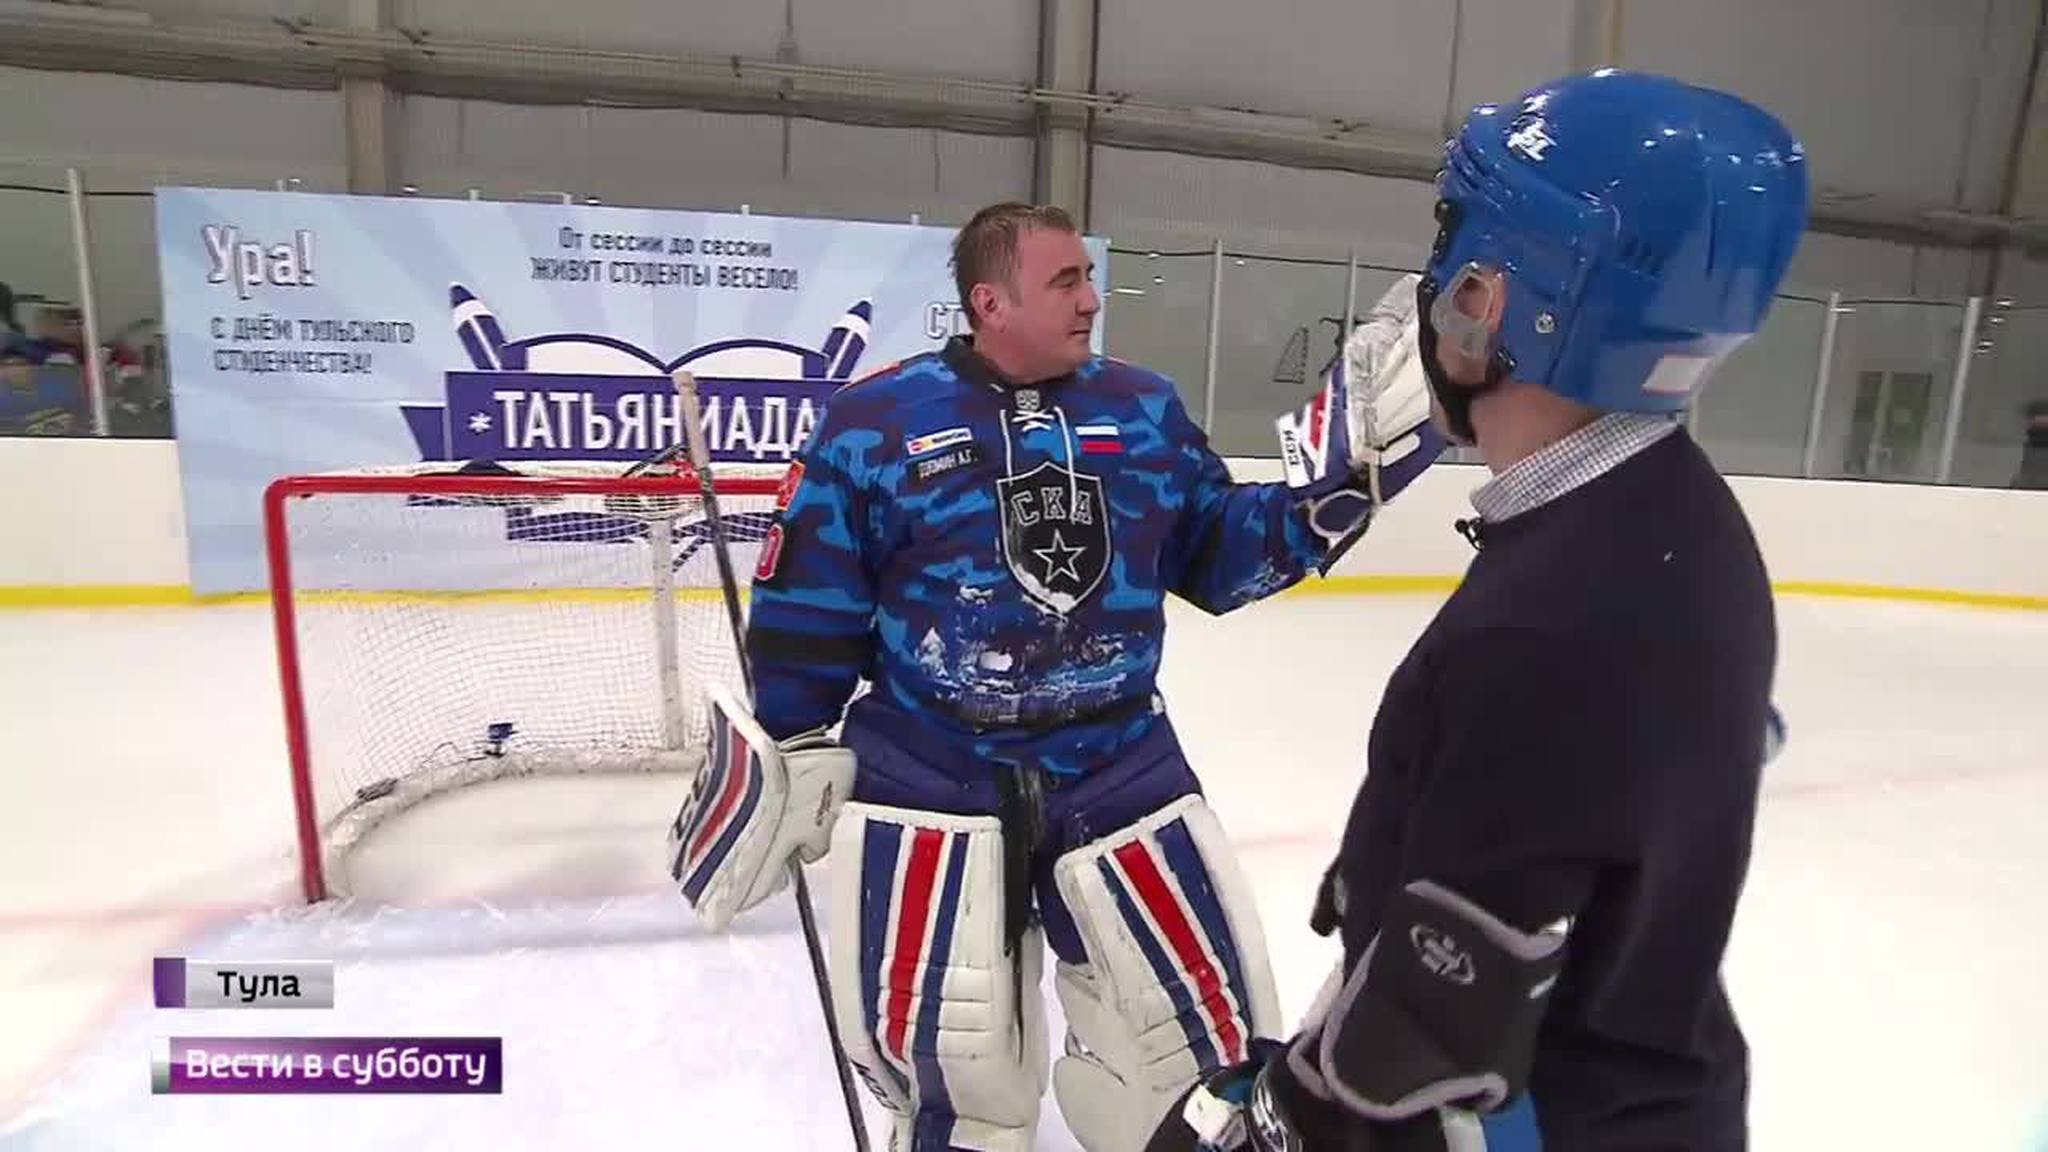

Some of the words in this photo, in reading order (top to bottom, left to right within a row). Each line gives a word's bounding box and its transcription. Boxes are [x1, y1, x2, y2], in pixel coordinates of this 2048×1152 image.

[558, 226, 583, 251] От
[590, 233, 663, 254] сессии
[669, 235, 694, 256] до
[701, 236, 772, 258] сессии
[202, 224, 317, 299] Ура!
[530, 256, 601, 283] ЖИВУТ
[608, 259, 711, 289] СТУДЕНТЫ
[717, 264, 799, 291] ВЕСЕЛО!
[211, 317, 224, 339] С
[233, 314, 292, 343] ДНЁМ
[299, 319, 415, 345] ТУЛЬСКОГО
[213, 349, 372, 376] СТУДЕНЧЕСТВА!
[493, 389, 816, 459] ТАТЬЯНИАДА
[1011, 486, 1093, 526] СКА
